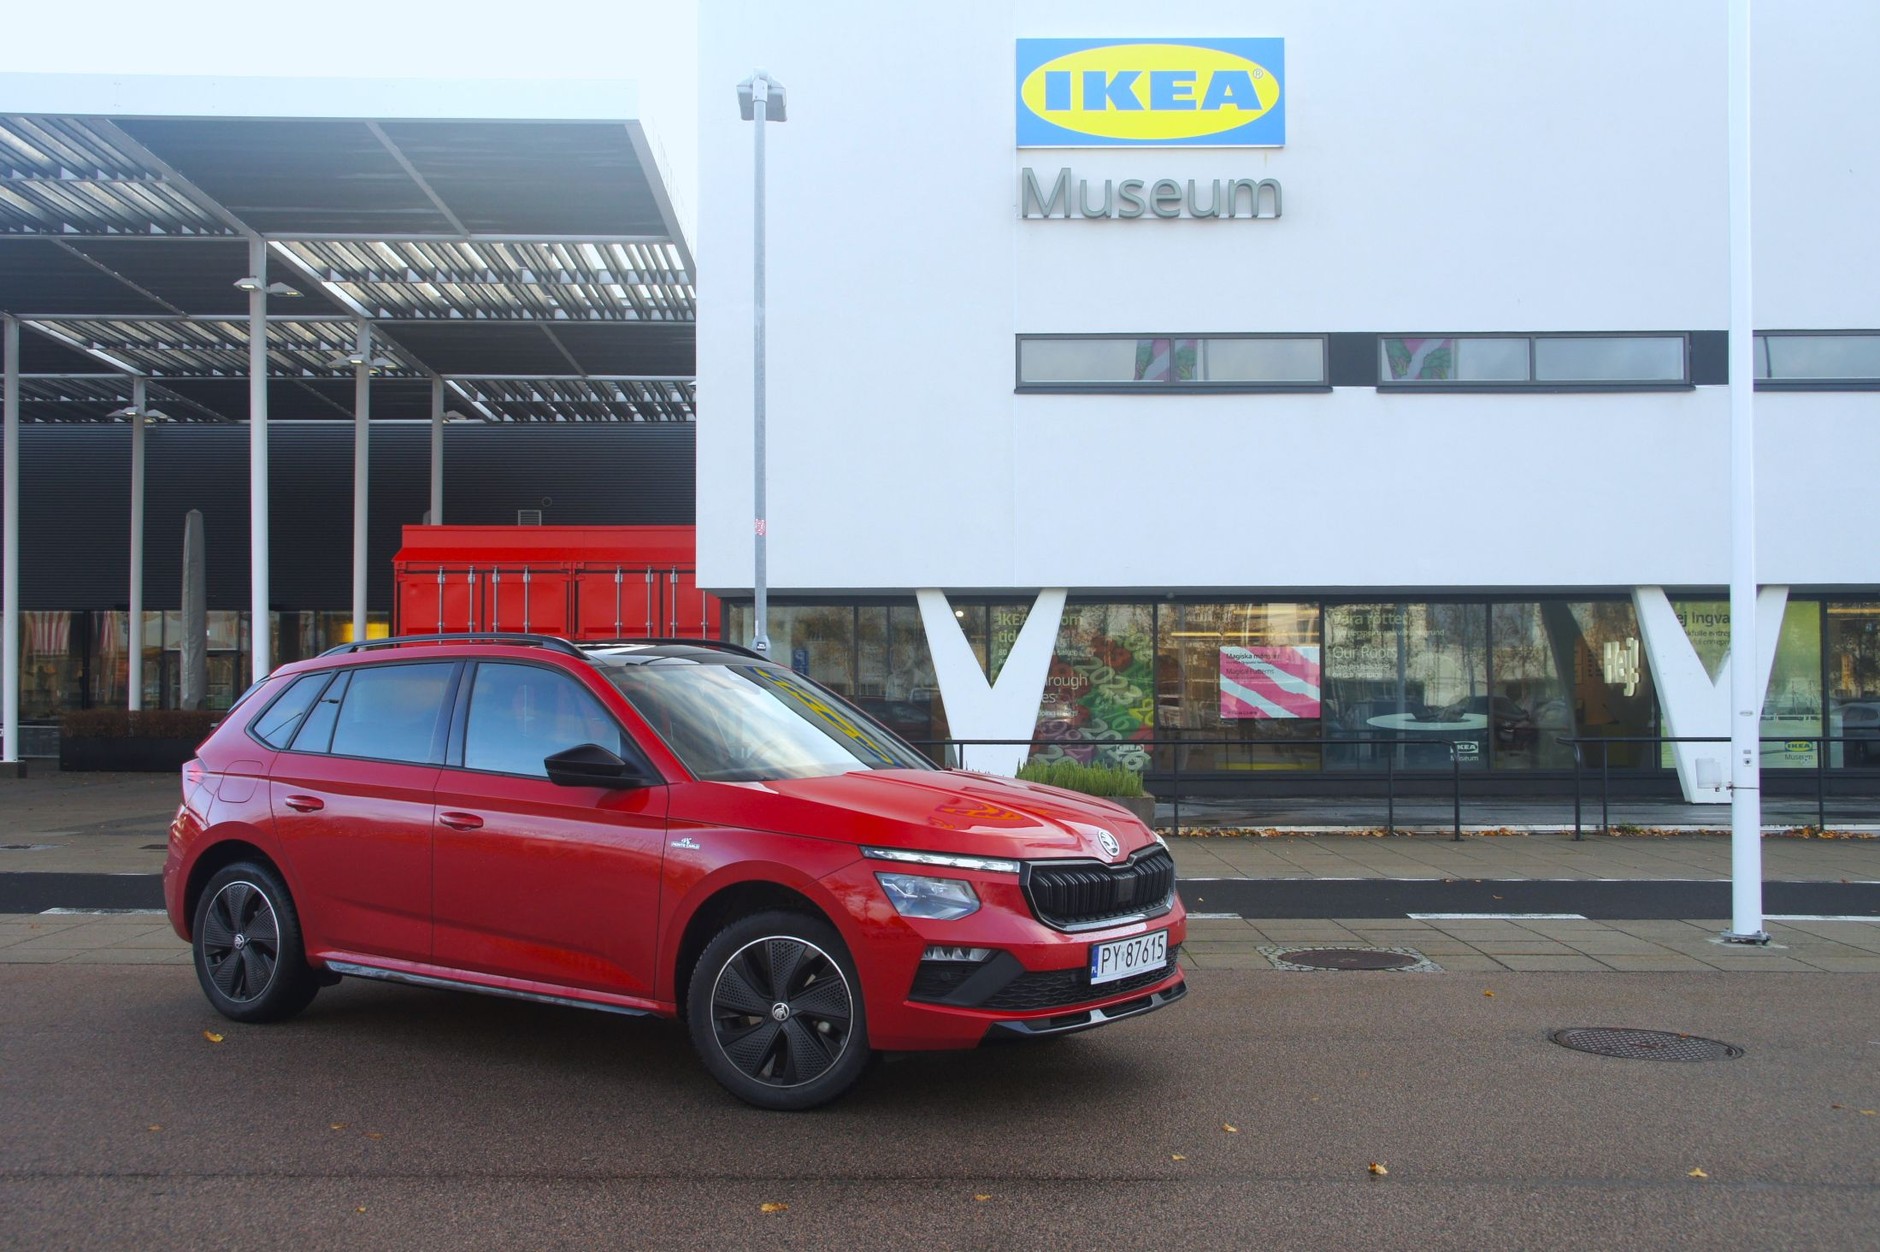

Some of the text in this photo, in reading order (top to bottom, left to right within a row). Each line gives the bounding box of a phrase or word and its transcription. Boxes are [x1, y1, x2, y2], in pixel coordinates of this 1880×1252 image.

[1045, 70, 1263, 111] IKEA
[1021, 167, 1283, 219] Museum
[1676, 611, 1731, 627] ej Ingva
[1333, 645, 1398, 659] Our Roots
[1046, 674, 1088, 690] rough
[1042, 693, 1057, 703] es
[1102, 934, 1164, 973] PY 87615
